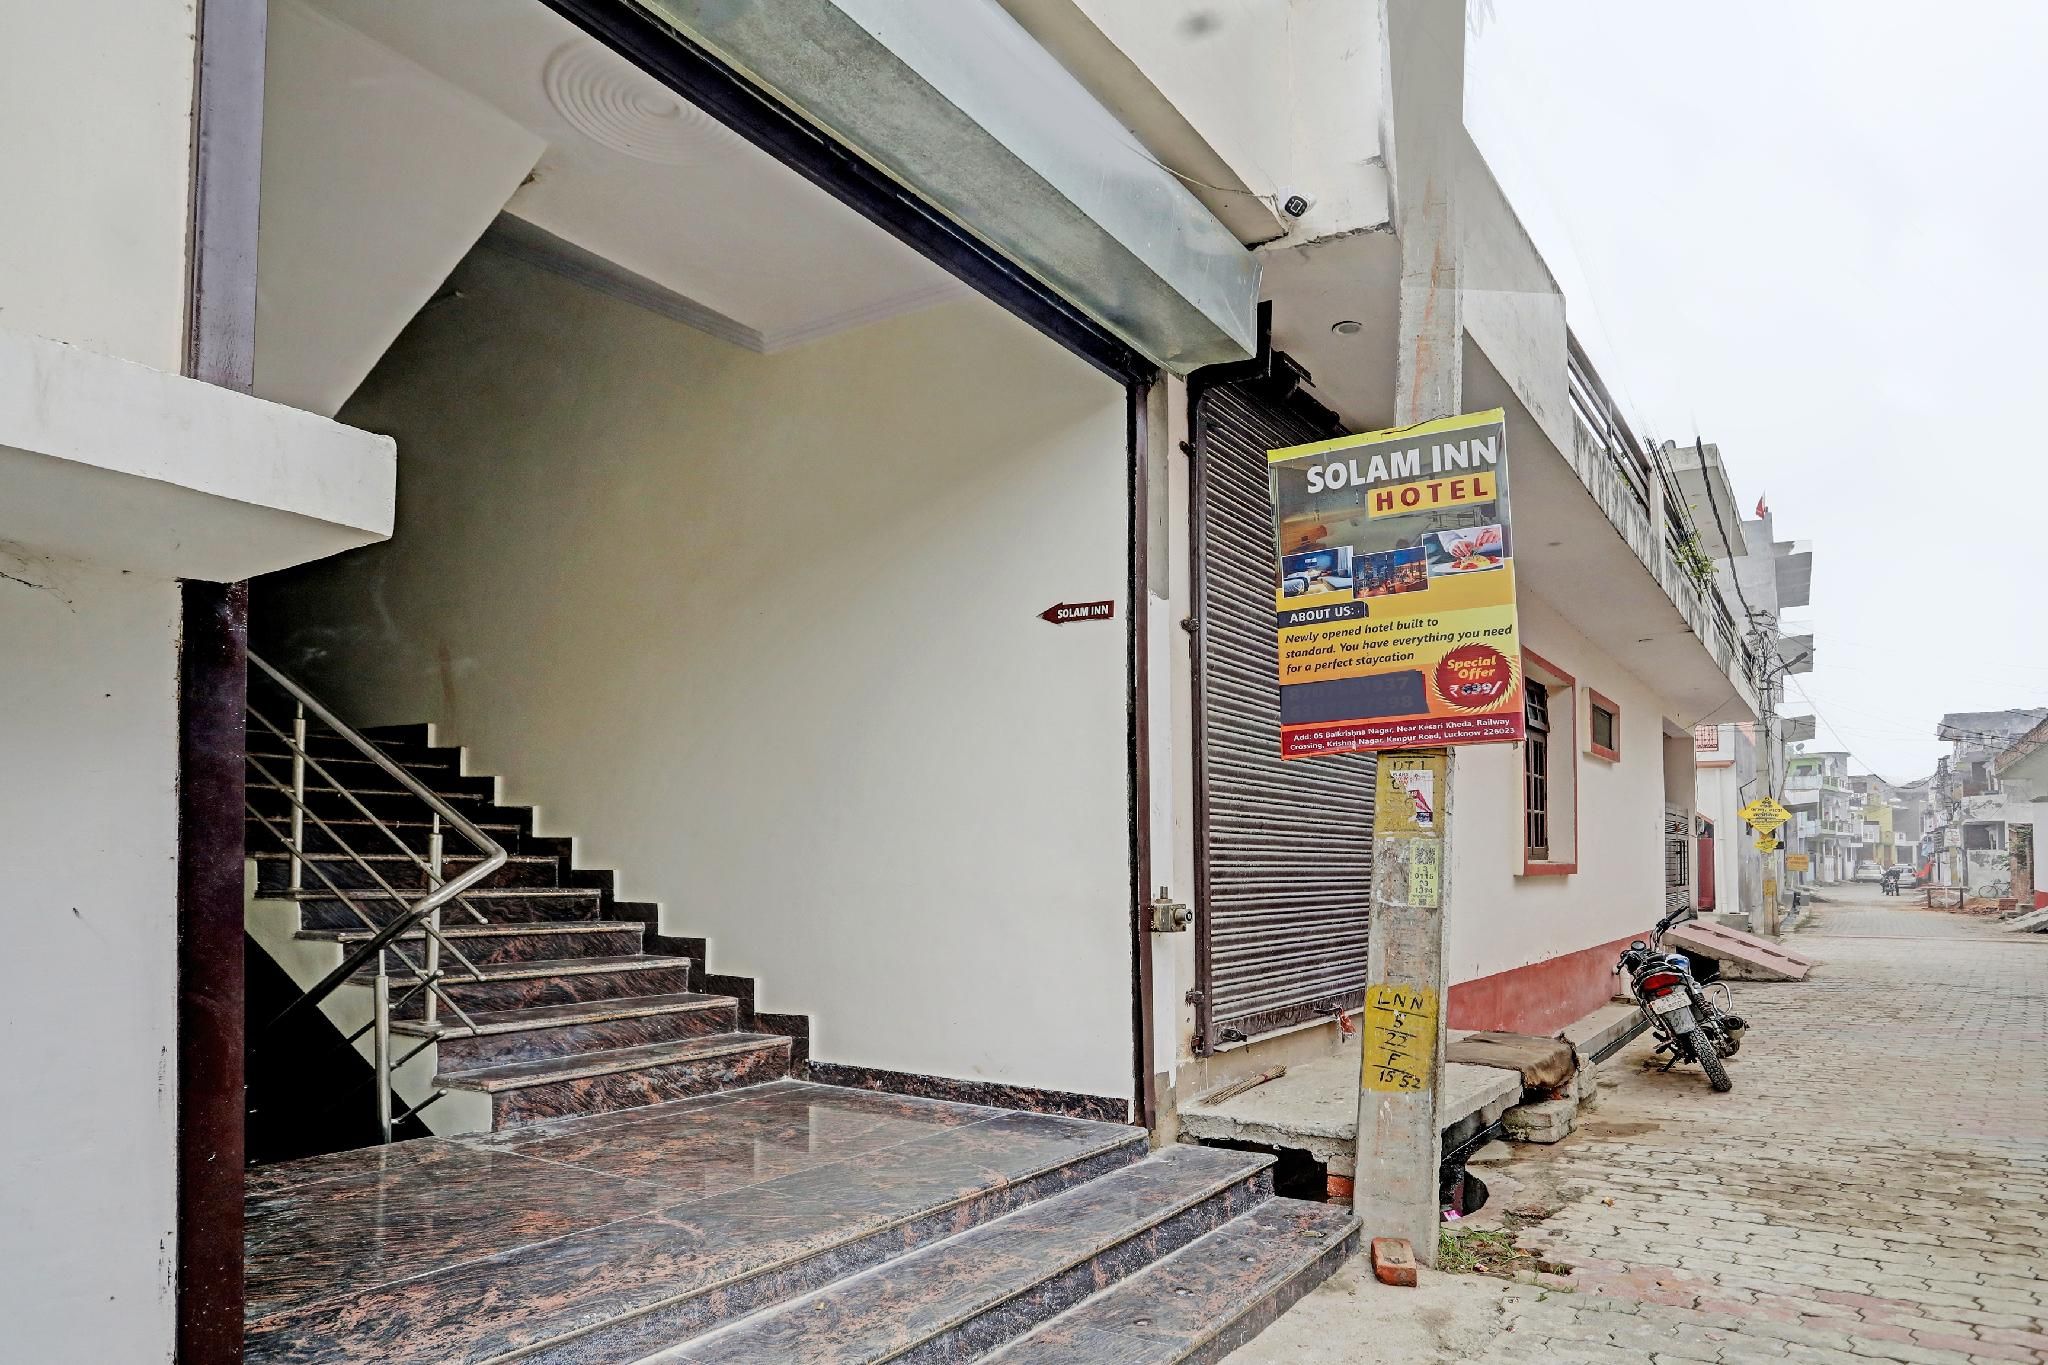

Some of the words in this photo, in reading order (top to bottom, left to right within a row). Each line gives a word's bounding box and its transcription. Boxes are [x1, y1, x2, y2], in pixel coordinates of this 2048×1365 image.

[1306, 448, 1421, 494] SOLAM
[1432, 436, 1497, 473] INN
[1376, 477, 1489, 512] HOTEL
[1057, 606, 1089, 619] SOLAM
[1091, 604, 1109, 615] INN
[1289, 608, 1331, 624] ABOUT
[1334, 605, 1355, 617] US:
[1285, 632, 1320, 644] Newly
[1322, 625, 1362, 640] opened
[1364, 621, 1394, 634] hotel
[1396, 618, 1424, 631] built
[1427, 618, 1439, 627] to
[1286, 644, 1336, 659] standard.
[1340, 642, 1360, 652] You
[1362, 639, 1392, 650] have
[1392, 632, 1454, 646] everything
[1457, 630, 1480, 642] you
[1483, 624, 1513, 637] need
[1286, 663, 1302, 675] for
[1304, 664, 1312, 672] a
[1314, 658, 1353, 672] perfect
[1355, 652, 1415, 667] staycation
[1447, 655, 1497, 672] Special
[1458, 667, 1496, 681] Offer
[1293, 733, 1312, 742] Add:
[1368, 726, 1395, 736] Nagar,
[1396, 725, 1417, 733] Near
[1445, 721, 1474, 729] Kheda,
[1476, 718, 1510, 727] Railway
[1326, 739, 1357, 748] Krishna
[1386, 734, 1417, 744] Kanpur
[1418, 731, 1442, 741] Road,
[1444, 730, 1481, 738] Lucknow
[1384, 1032, 1408, 1048] 22
[1388, 1052, 1401, 1066] F
